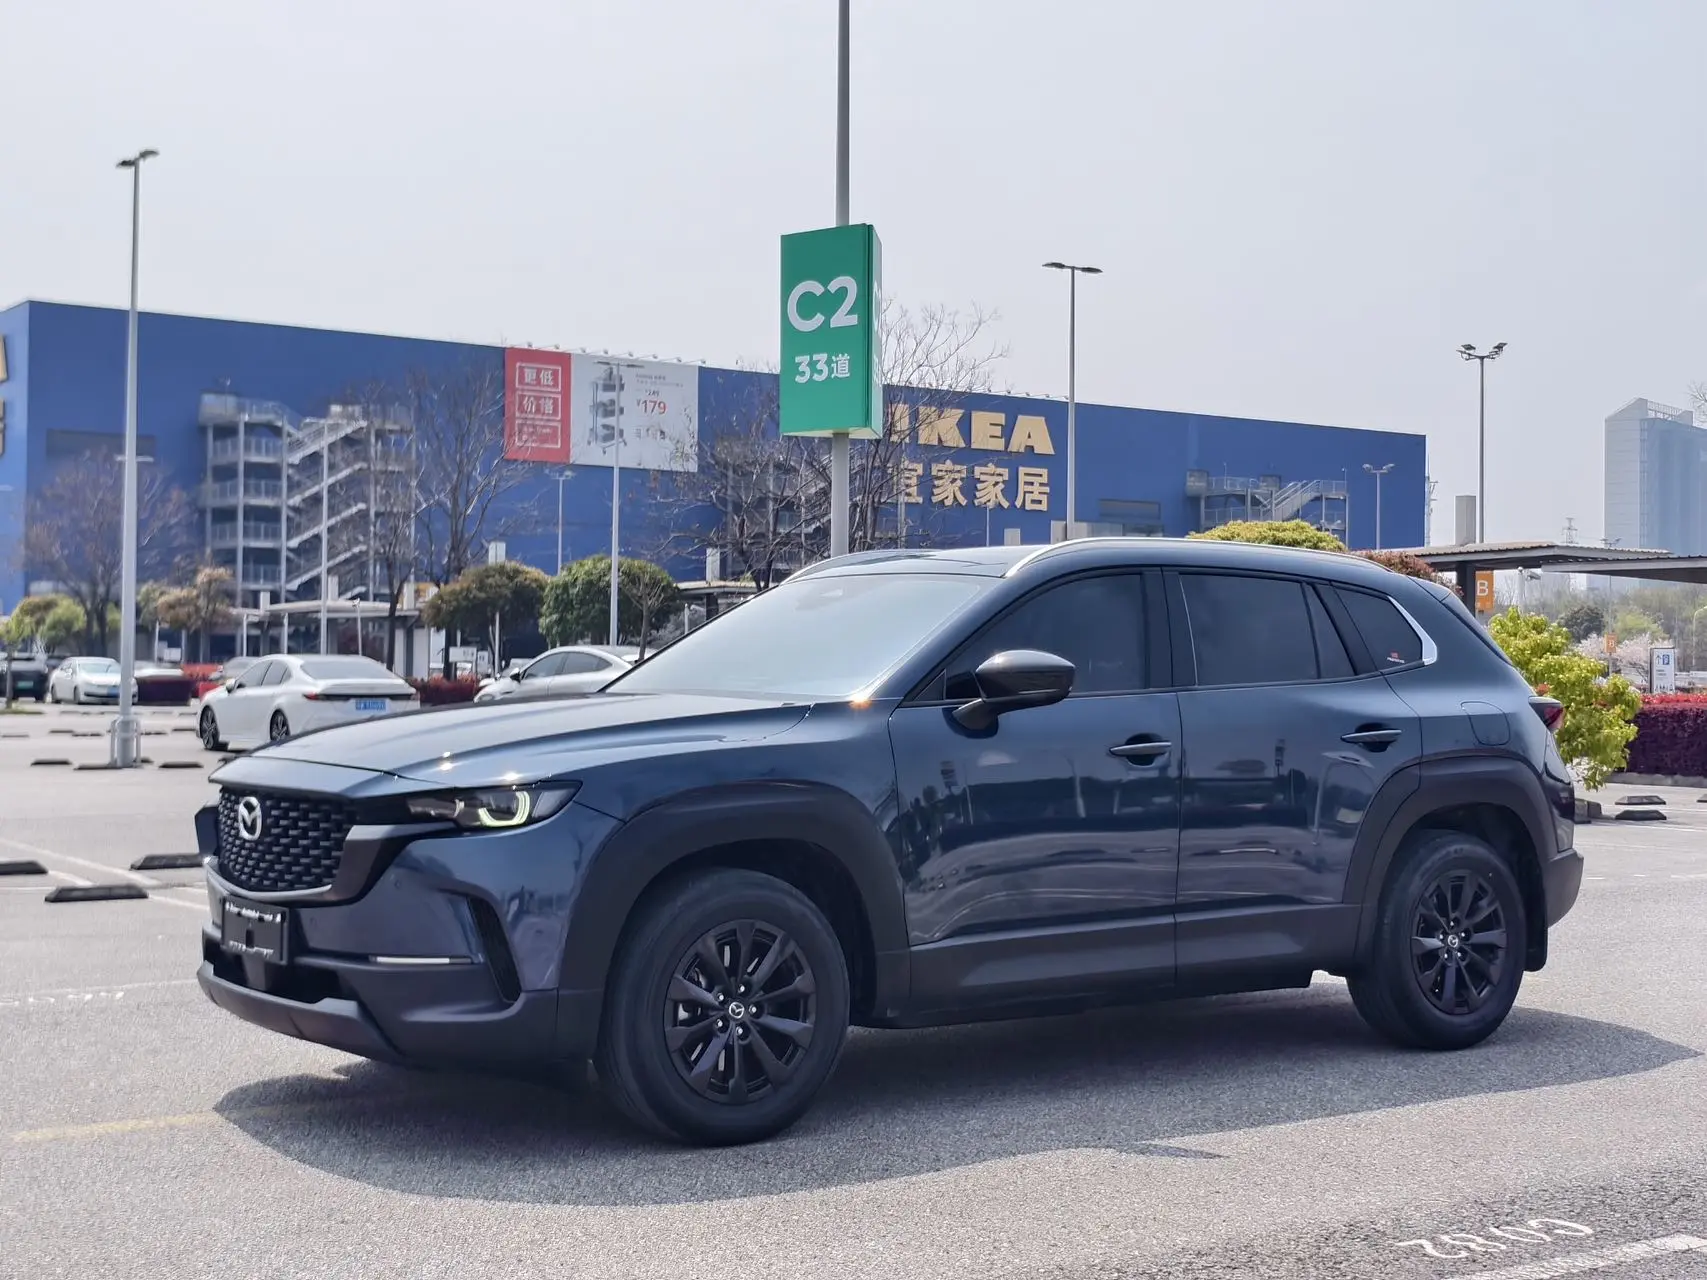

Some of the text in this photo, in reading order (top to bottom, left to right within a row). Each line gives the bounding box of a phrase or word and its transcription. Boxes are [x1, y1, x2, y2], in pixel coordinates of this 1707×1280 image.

[787, 276, 858, 332] C2
[795, 353, 850, 383] 33道
[889, 403, 1055, 455] IKEA
[882, 459, 1049, 511] 宜家家居
[1477, 580, 1489, 596] B
